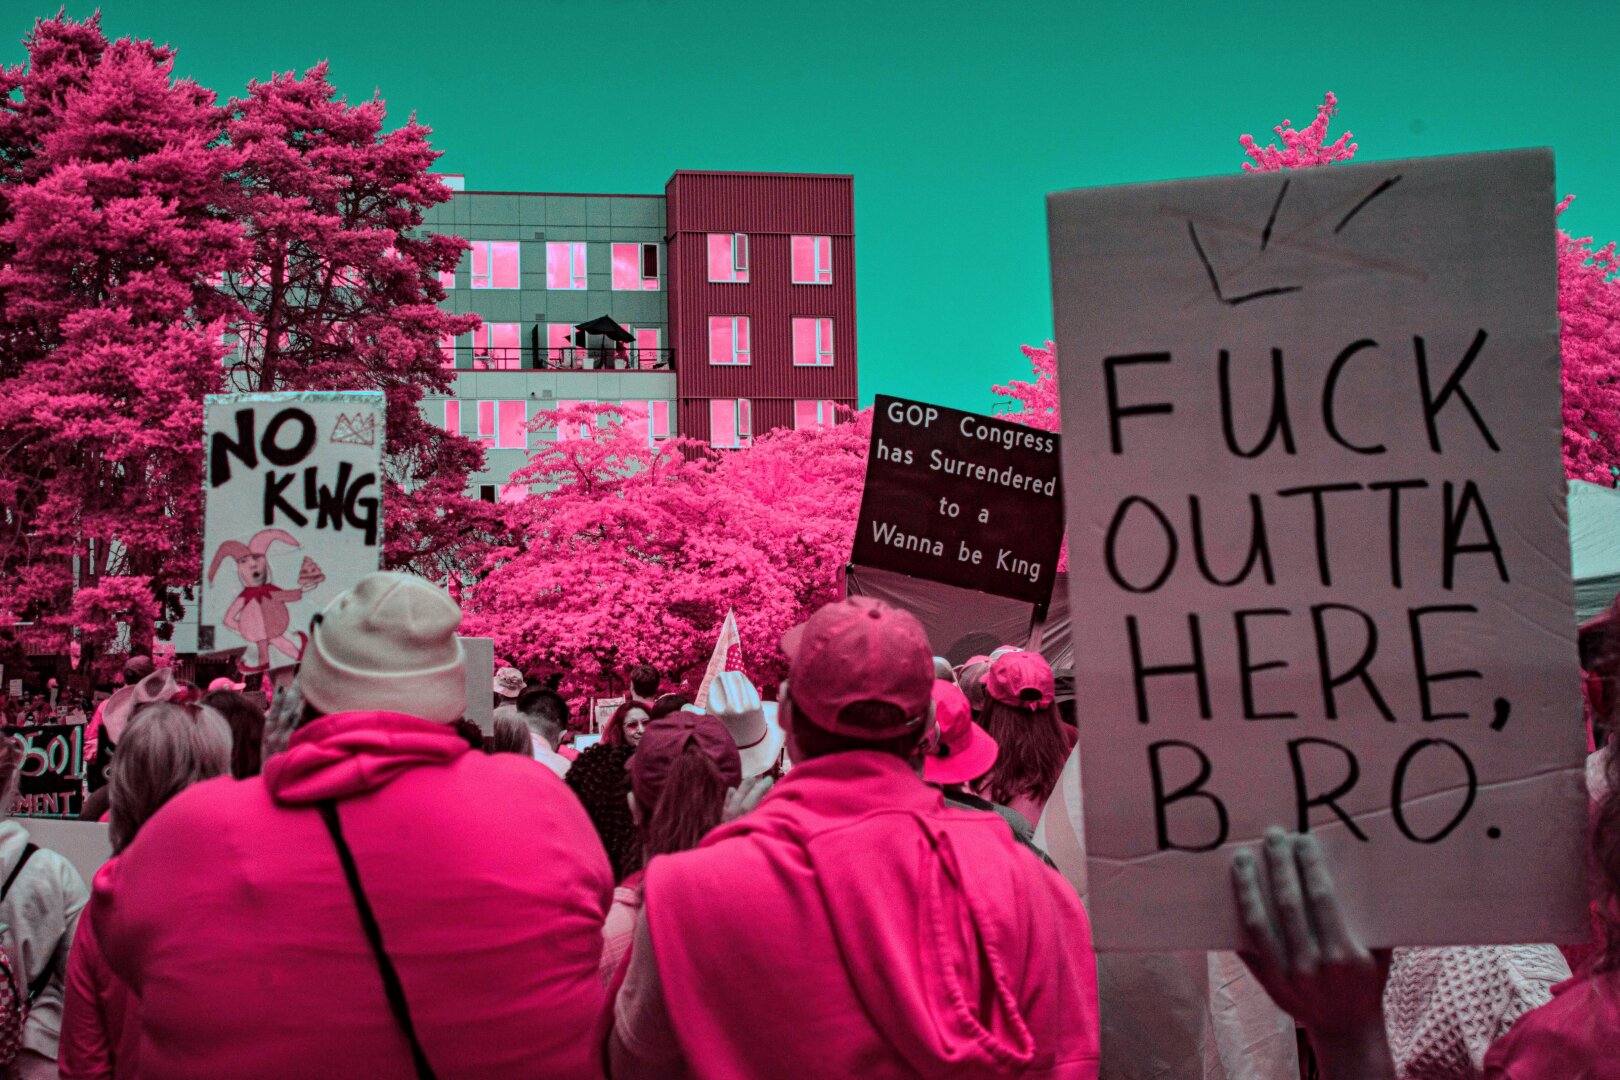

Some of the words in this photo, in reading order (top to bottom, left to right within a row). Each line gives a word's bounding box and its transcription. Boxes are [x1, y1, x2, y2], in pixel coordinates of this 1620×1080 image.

[887, 401, 939, 428] GOP
[959, 416, 1054, 453] Congress
[1102, 328, 1501, 458] FUCK
[210, 406, 317, 488] NO
[876, 438, 914, 465] has
[929, 448, 1057, 496] Surrendered
[263, 461, 379, 546] KING
[939, 496, 960, 518] to
[977, 508, 990, 524] a
[1104, 479, 1510, 593] OUTTA
[872, 520, 945, 557] Wanna
[957, 540, 983, 564] be
[996, 548, 1041, 583] King
[1125, 603, 1511, 731] HERE,
